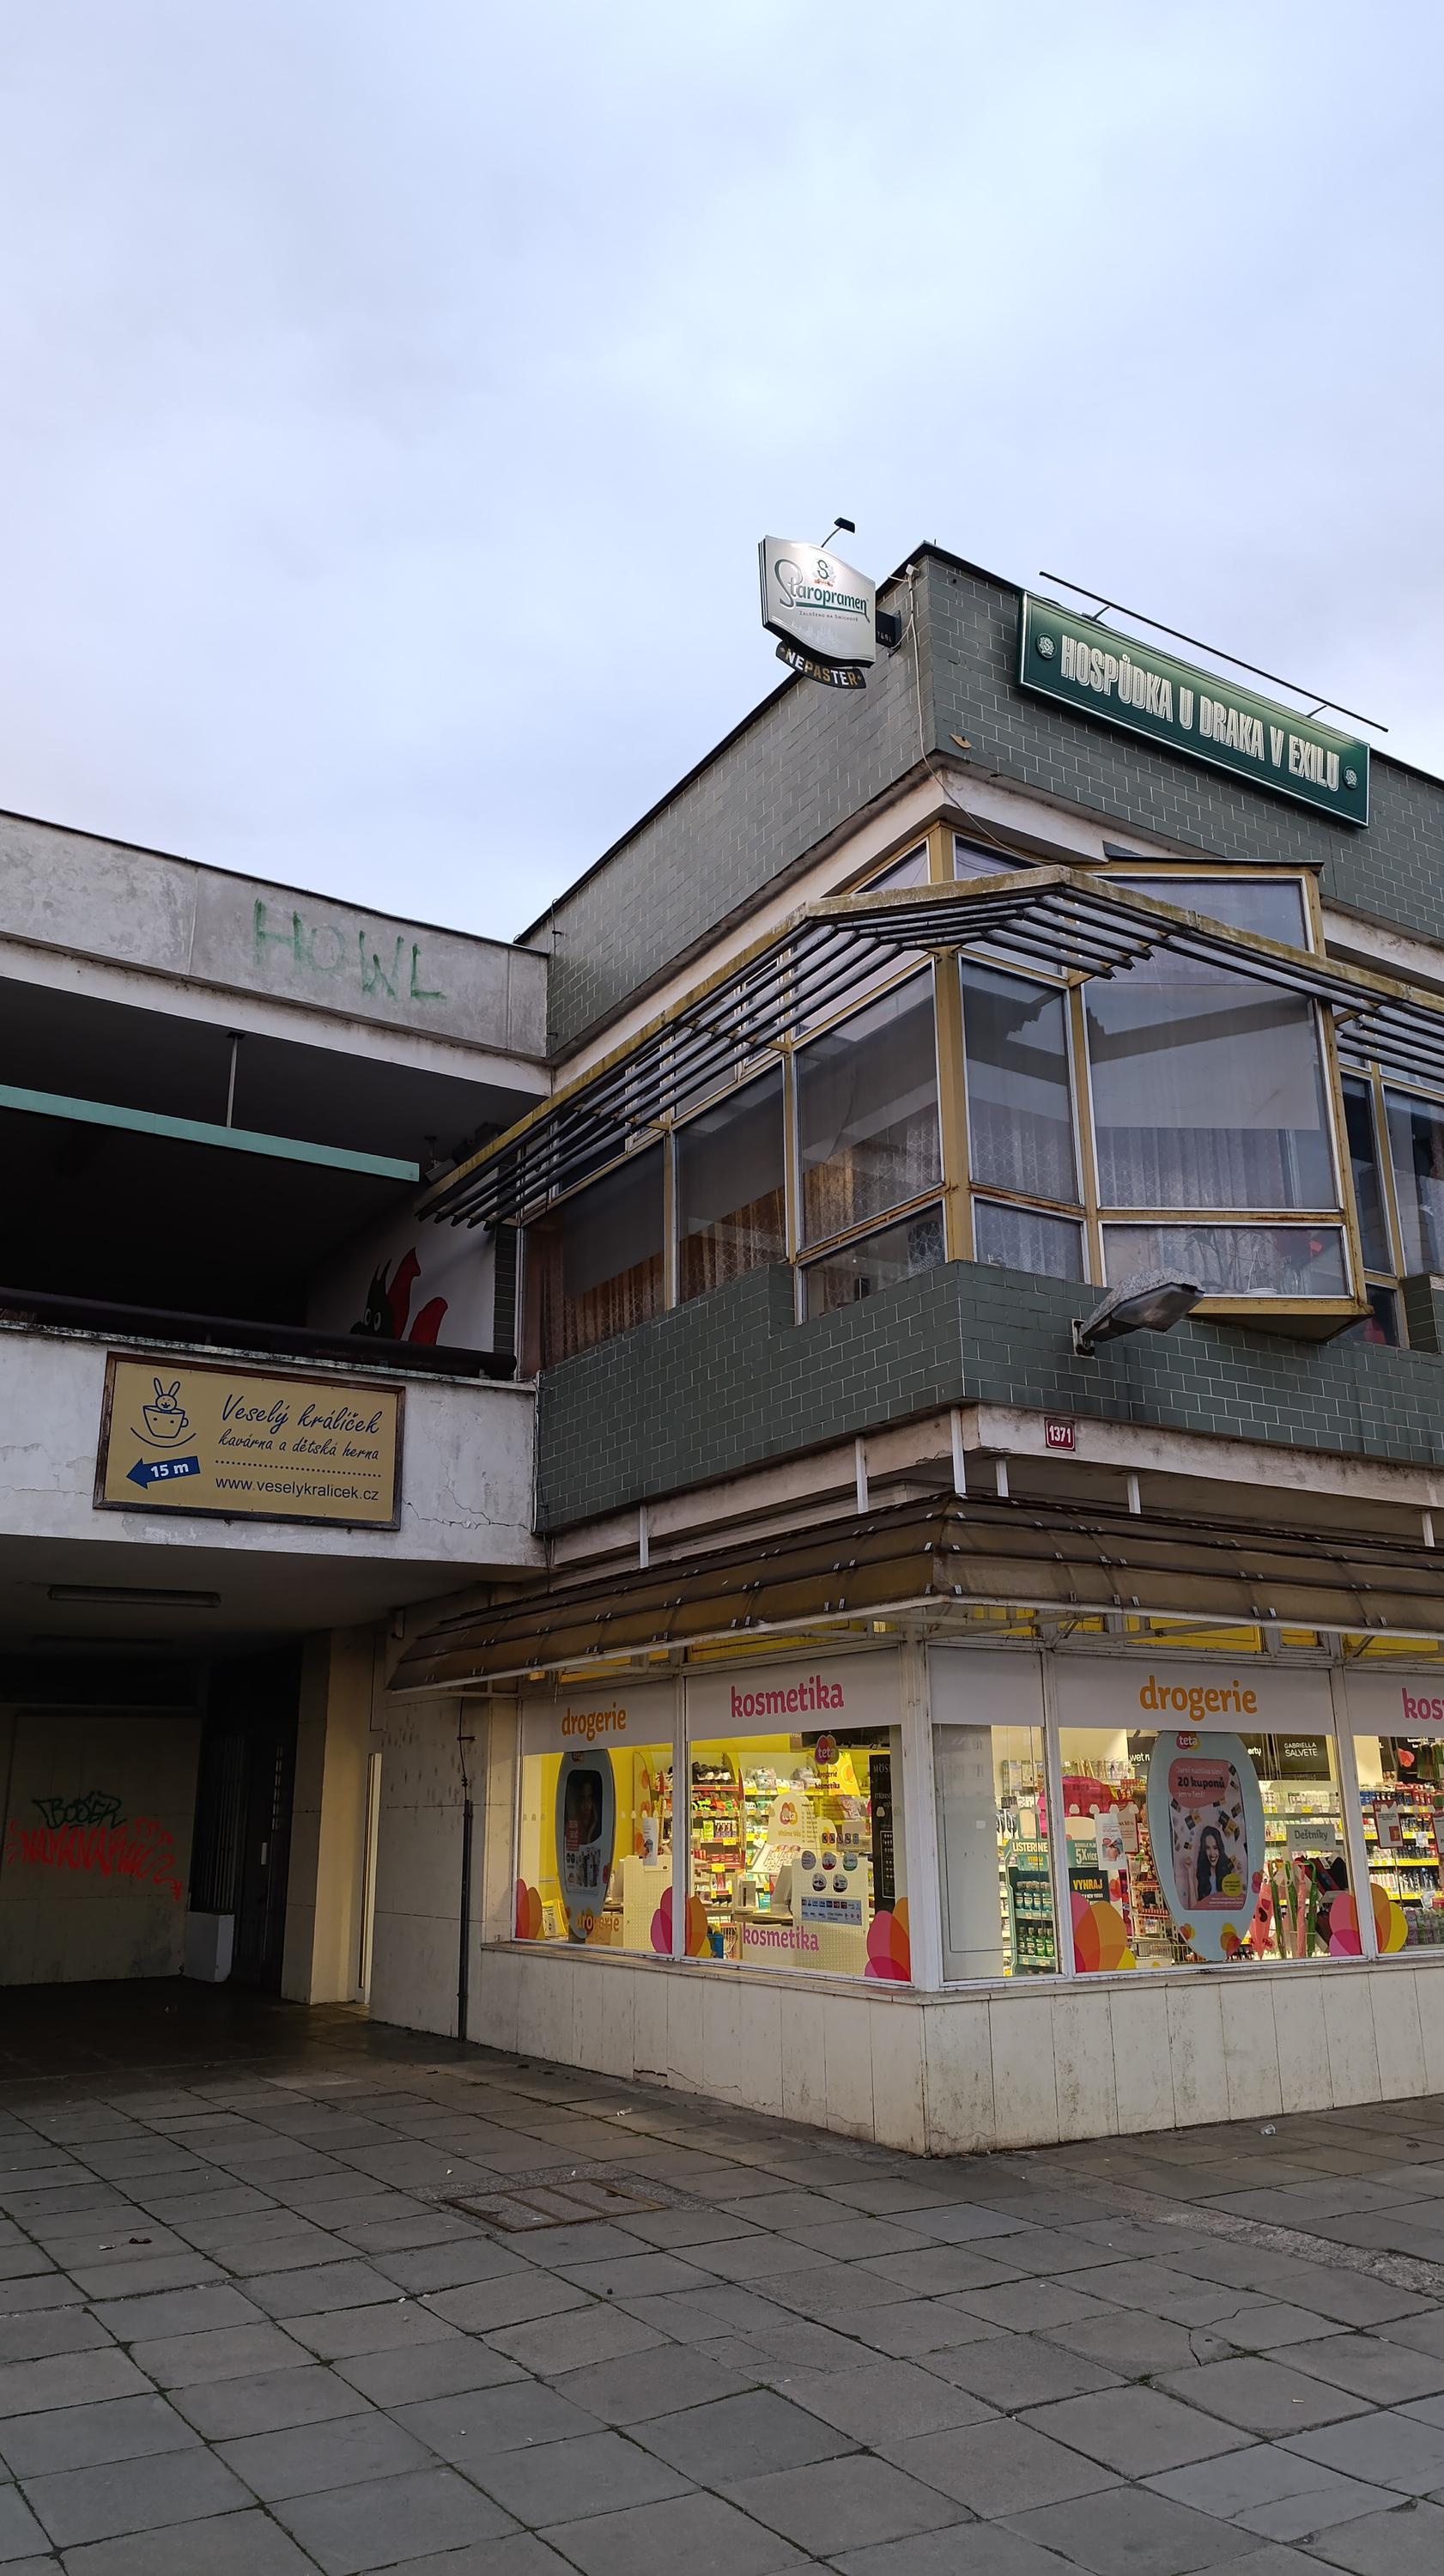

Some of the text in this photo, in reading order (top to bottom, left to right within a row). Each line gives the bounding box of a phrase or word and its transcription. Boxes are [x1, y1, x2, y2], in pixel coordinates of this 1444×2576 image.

[774, 558, 870, 622] Staropramen
[784, 648, 858, 686] NEPASTER
[1060, 634, 1340, 792] HOSPŮDKA U DRAKA V EXILU
[253, 896, 446, 1002] HOWL
[221, 1394, 383, 1435] Veselý králíček
[1049, 1425, 1071, 1443] 1371
[218, 1429, 379, 1461] kavárna a dětská herna
[150, 1462, 189, 1479] 15 m
[215, 1477, 379, 1501] www.veselykralicek.cz
[731, 1674, 845, 1718] kosmetika
[1139, 1674, 1258, 1722] drogerie
[1401, 1687, 1444, 1720] kos
[561, 1702, 627, 1741] drogerie
[1179, 1734, 1198, 1746] teta
[818, 1747, 836, 1759] teta
[1129, 1753, 1144, 1763] wet
[1284, 1748, 1319, 1758] SALVETE
[816, 1771, 838, 1780] drogerie
[873, 1762, 891, 1773] MÖS
[815, 1782, 840, 1790] kosmetika
[1177, 1776, 1225, 1790] 20 kuponů
[1294, 1829, 1328, 1842] Deštníky
[1012, 1842, 1049, 1853] LISTERINE
[1076, 1849, 1088, 1865] 5X
[1072, 1879, 1103, 1891] VYHRAJ
[576, 1911, 620, 1934] droerie
[743, 1923, 820, 1951] kosmetika
